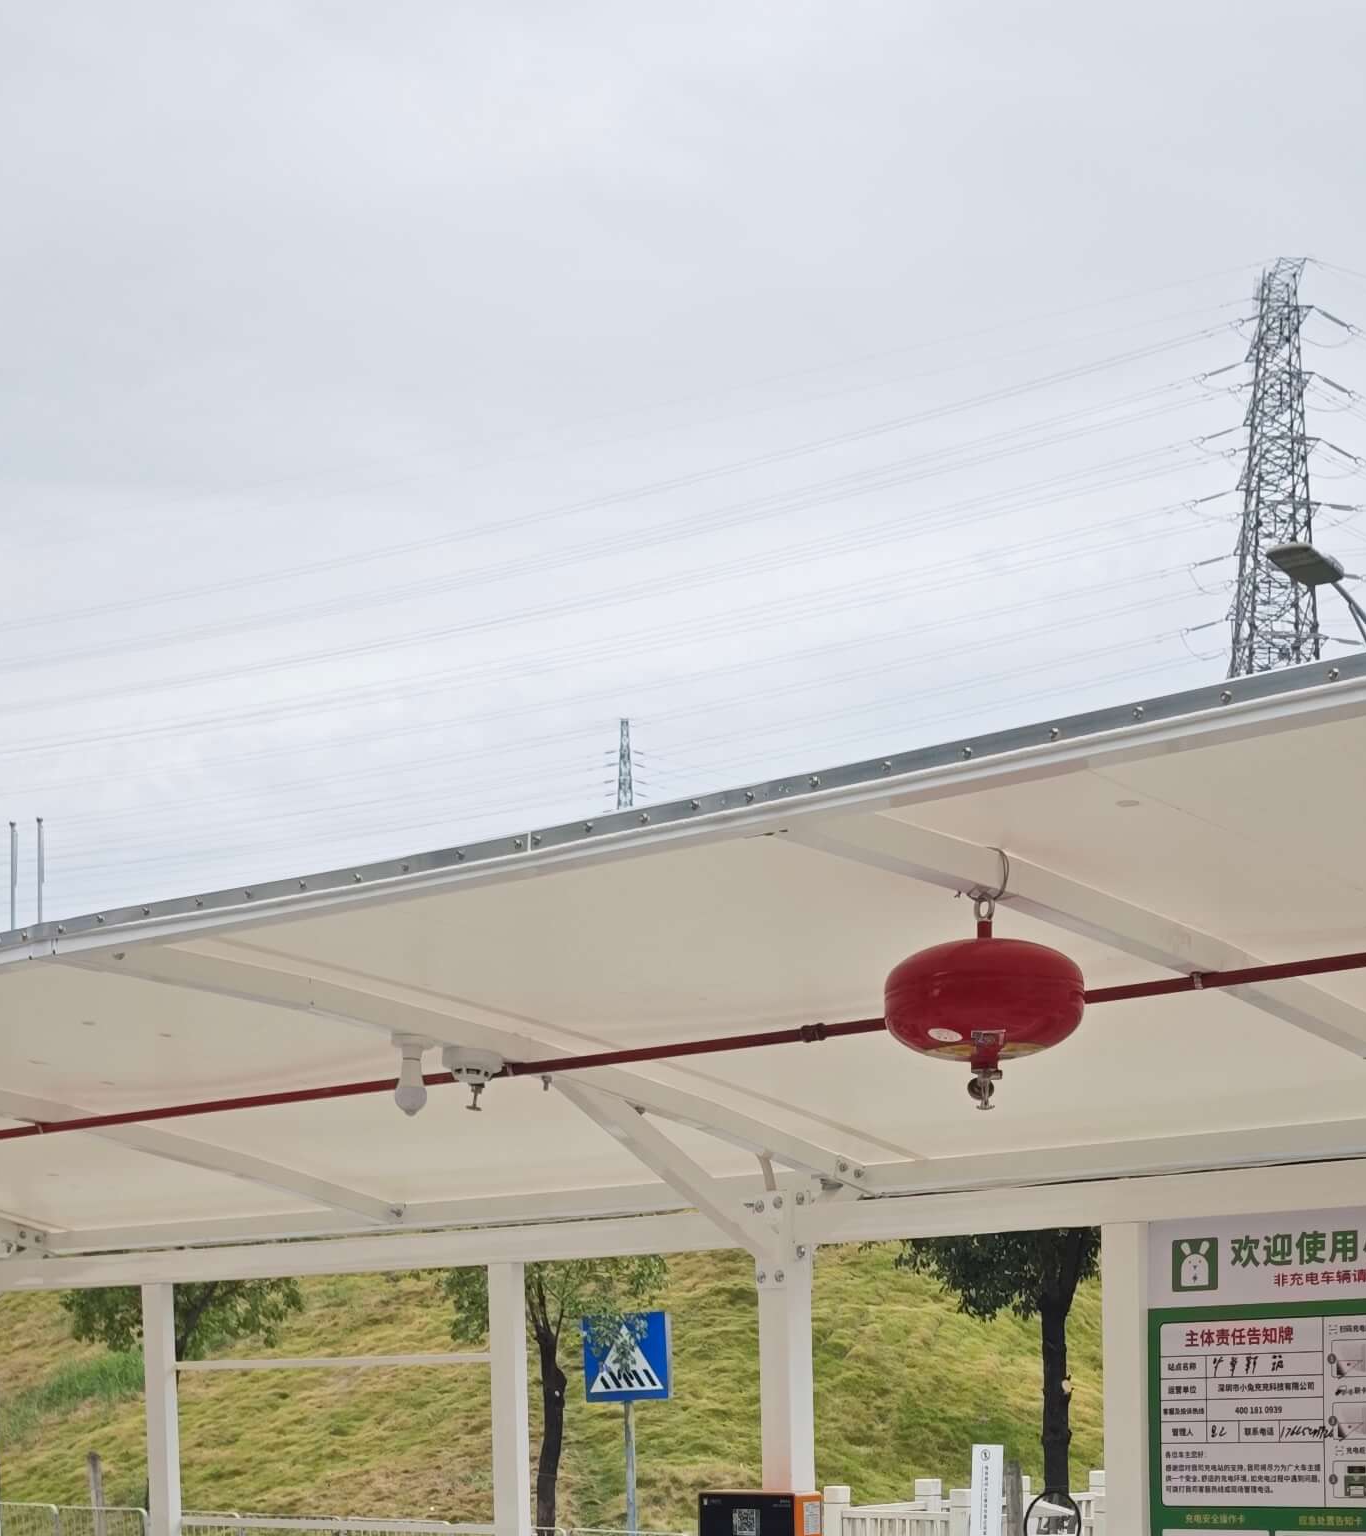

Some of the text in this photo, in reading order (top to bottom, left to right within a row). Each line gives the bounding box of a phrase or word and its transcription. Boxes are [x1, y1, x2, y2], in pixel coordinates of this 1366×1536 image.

[1185, 1326, 1294, 1348] 主体责任告知牌
[1235, 1406, 1248, 1415] 400
